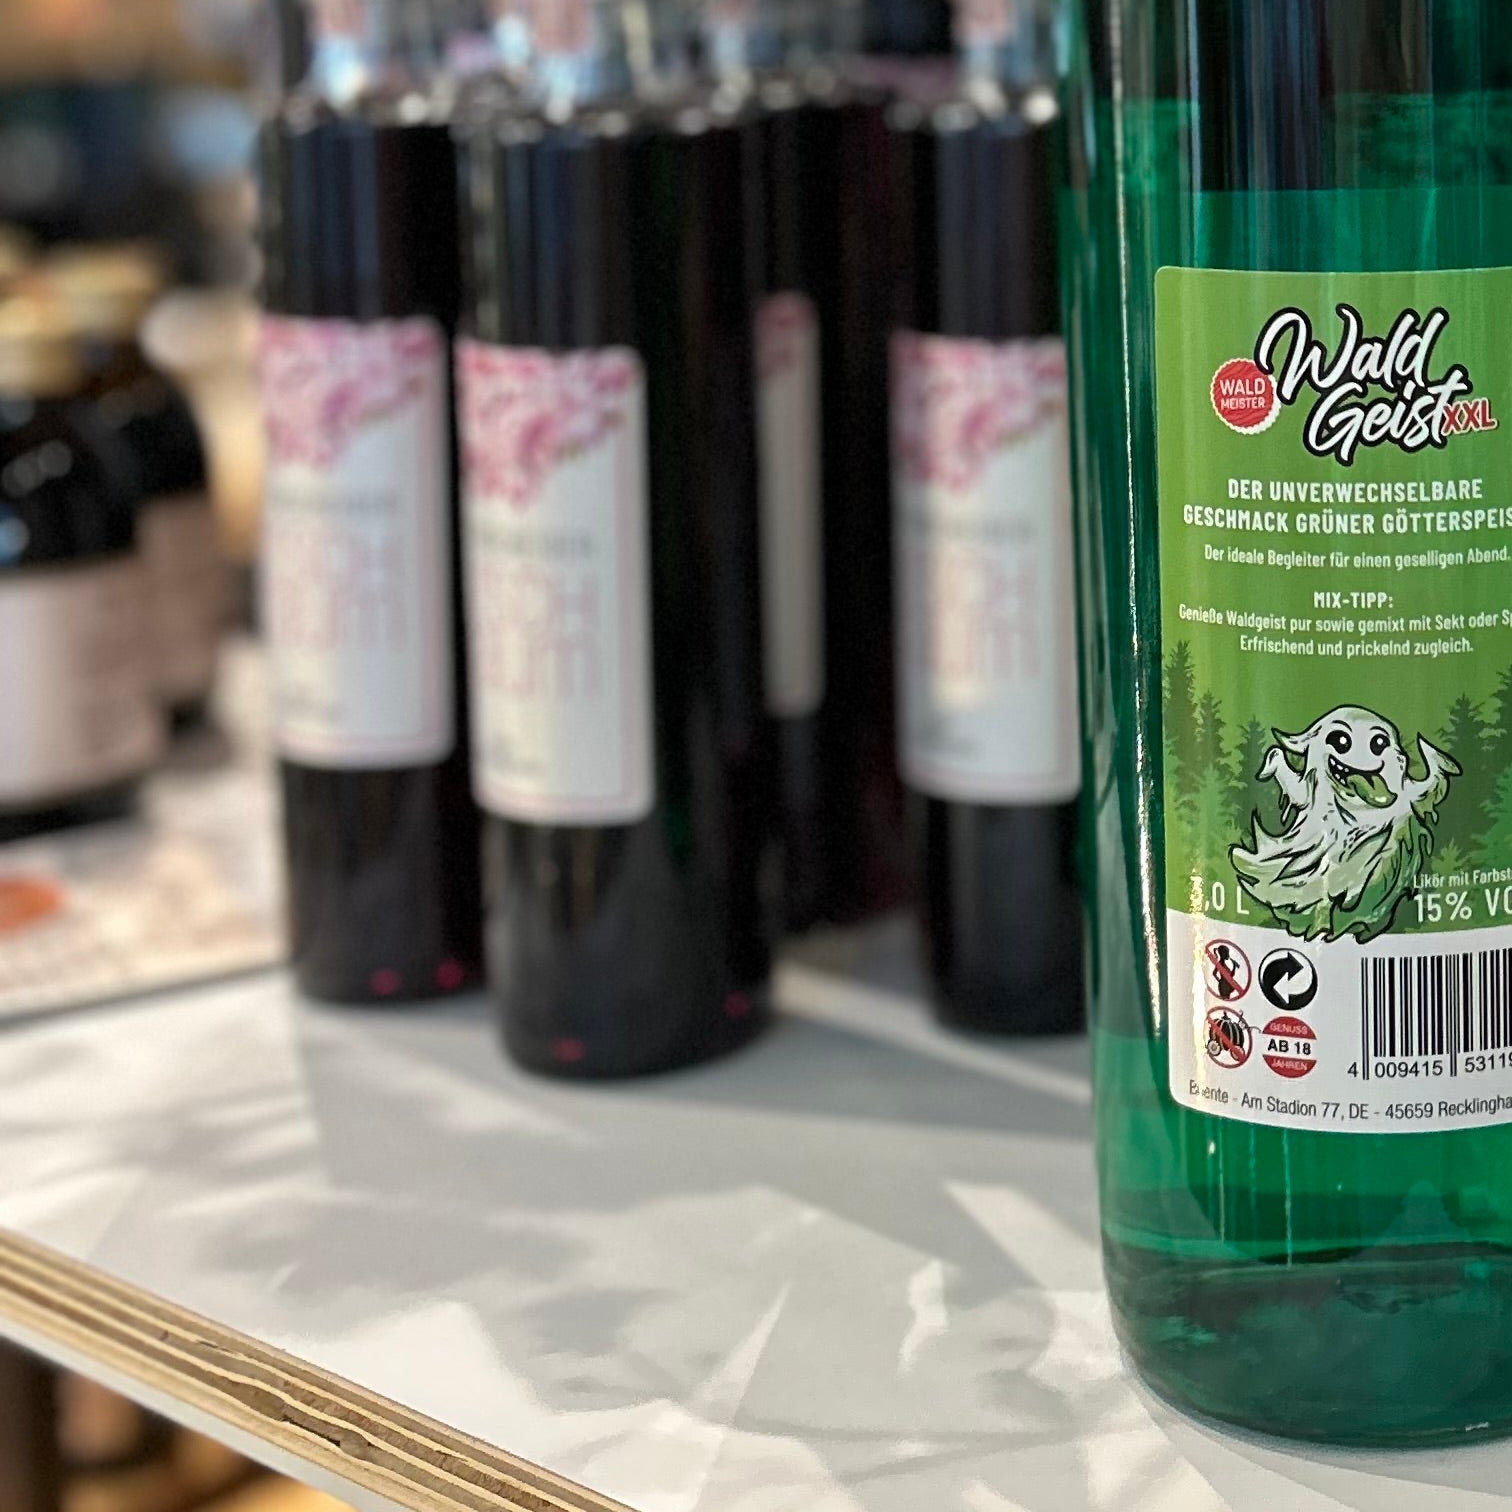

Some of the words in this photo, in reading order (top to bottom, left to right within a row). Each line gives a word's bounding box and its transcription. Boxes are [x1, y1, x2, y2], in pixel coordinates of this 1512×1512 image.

[1254, 303, 1449, 405] Wald
[1219, 377, 1266, 396] WALD
[1220, 396, 1266, 410] MEISTER
[1303, 364, 1473, 466] Geist
[1440, 397, 1498, 437] XXL
[1228, 478, 1263, 500] DER
[1269, 478, 1483, 503] UNVERWECHSELBARE
[1183, 504, 1289, 533] GESCHMACK
[1295, 508, 1375, 534] GRÜNER
[1204, 544, 1224, 561] Der
[1227, 546, 1265, 565] ideale
[1267, 549, 1326, 570] Begleiter
[1329, 551, 1349, 568] für
[1353, 551, 1391, 568] einen
[1394, 549, 1463, 571] geselligen
[1467, 545, 1512, 564] Abend.
[1313, 591, 1393, 609] MIX-TIPP:
[1179, 603, 1223, 625] Genieße
[1226, 609, 1286, 632] Waldgeist
[1290, 618, 1312, 634] pur
[1315, 616, 1354, 633] sowie
[1358, 616, 1405, 636] gemixt
[1408, 614, 1432, 631] mit
[1435, 613, 1465, 630] Sekt
[1468, 611, 1499, 628] oder
[1240, 634, 1314, 655] Erfrischend
[1317, 640, 1343, 656] und
[1347, 639, 1410, 660] prickelnd
[1414, 637, 1474, 658] zugleich.
[1413, 873, 1445, 889] Likör
[1448, 871, 1469, 887] mit
[1236, 885, 1250, 915] L
[1413, 891, 1473, 923] 15%
[1270, 1021, 1308, 1035] GENUSS
[1267, 1039, 1289, 1053] AB
[1295, 1042, 1311, 1055] 18
[1271, 1059, 1308, 1071] JAHREN
[1347, 1062, 1358, 1078] 4
[1374, 1060, 1443, 1079] 009415
[1241, 1092, 1263, 1111] Am
[1266, 1096, 1317, 1117] Stadion
[1321, 1102, 1345, 1121] 77,
[1349, 1103, 1369, 1120] DE
[1385, 1102, 1433, 1120] 45659
